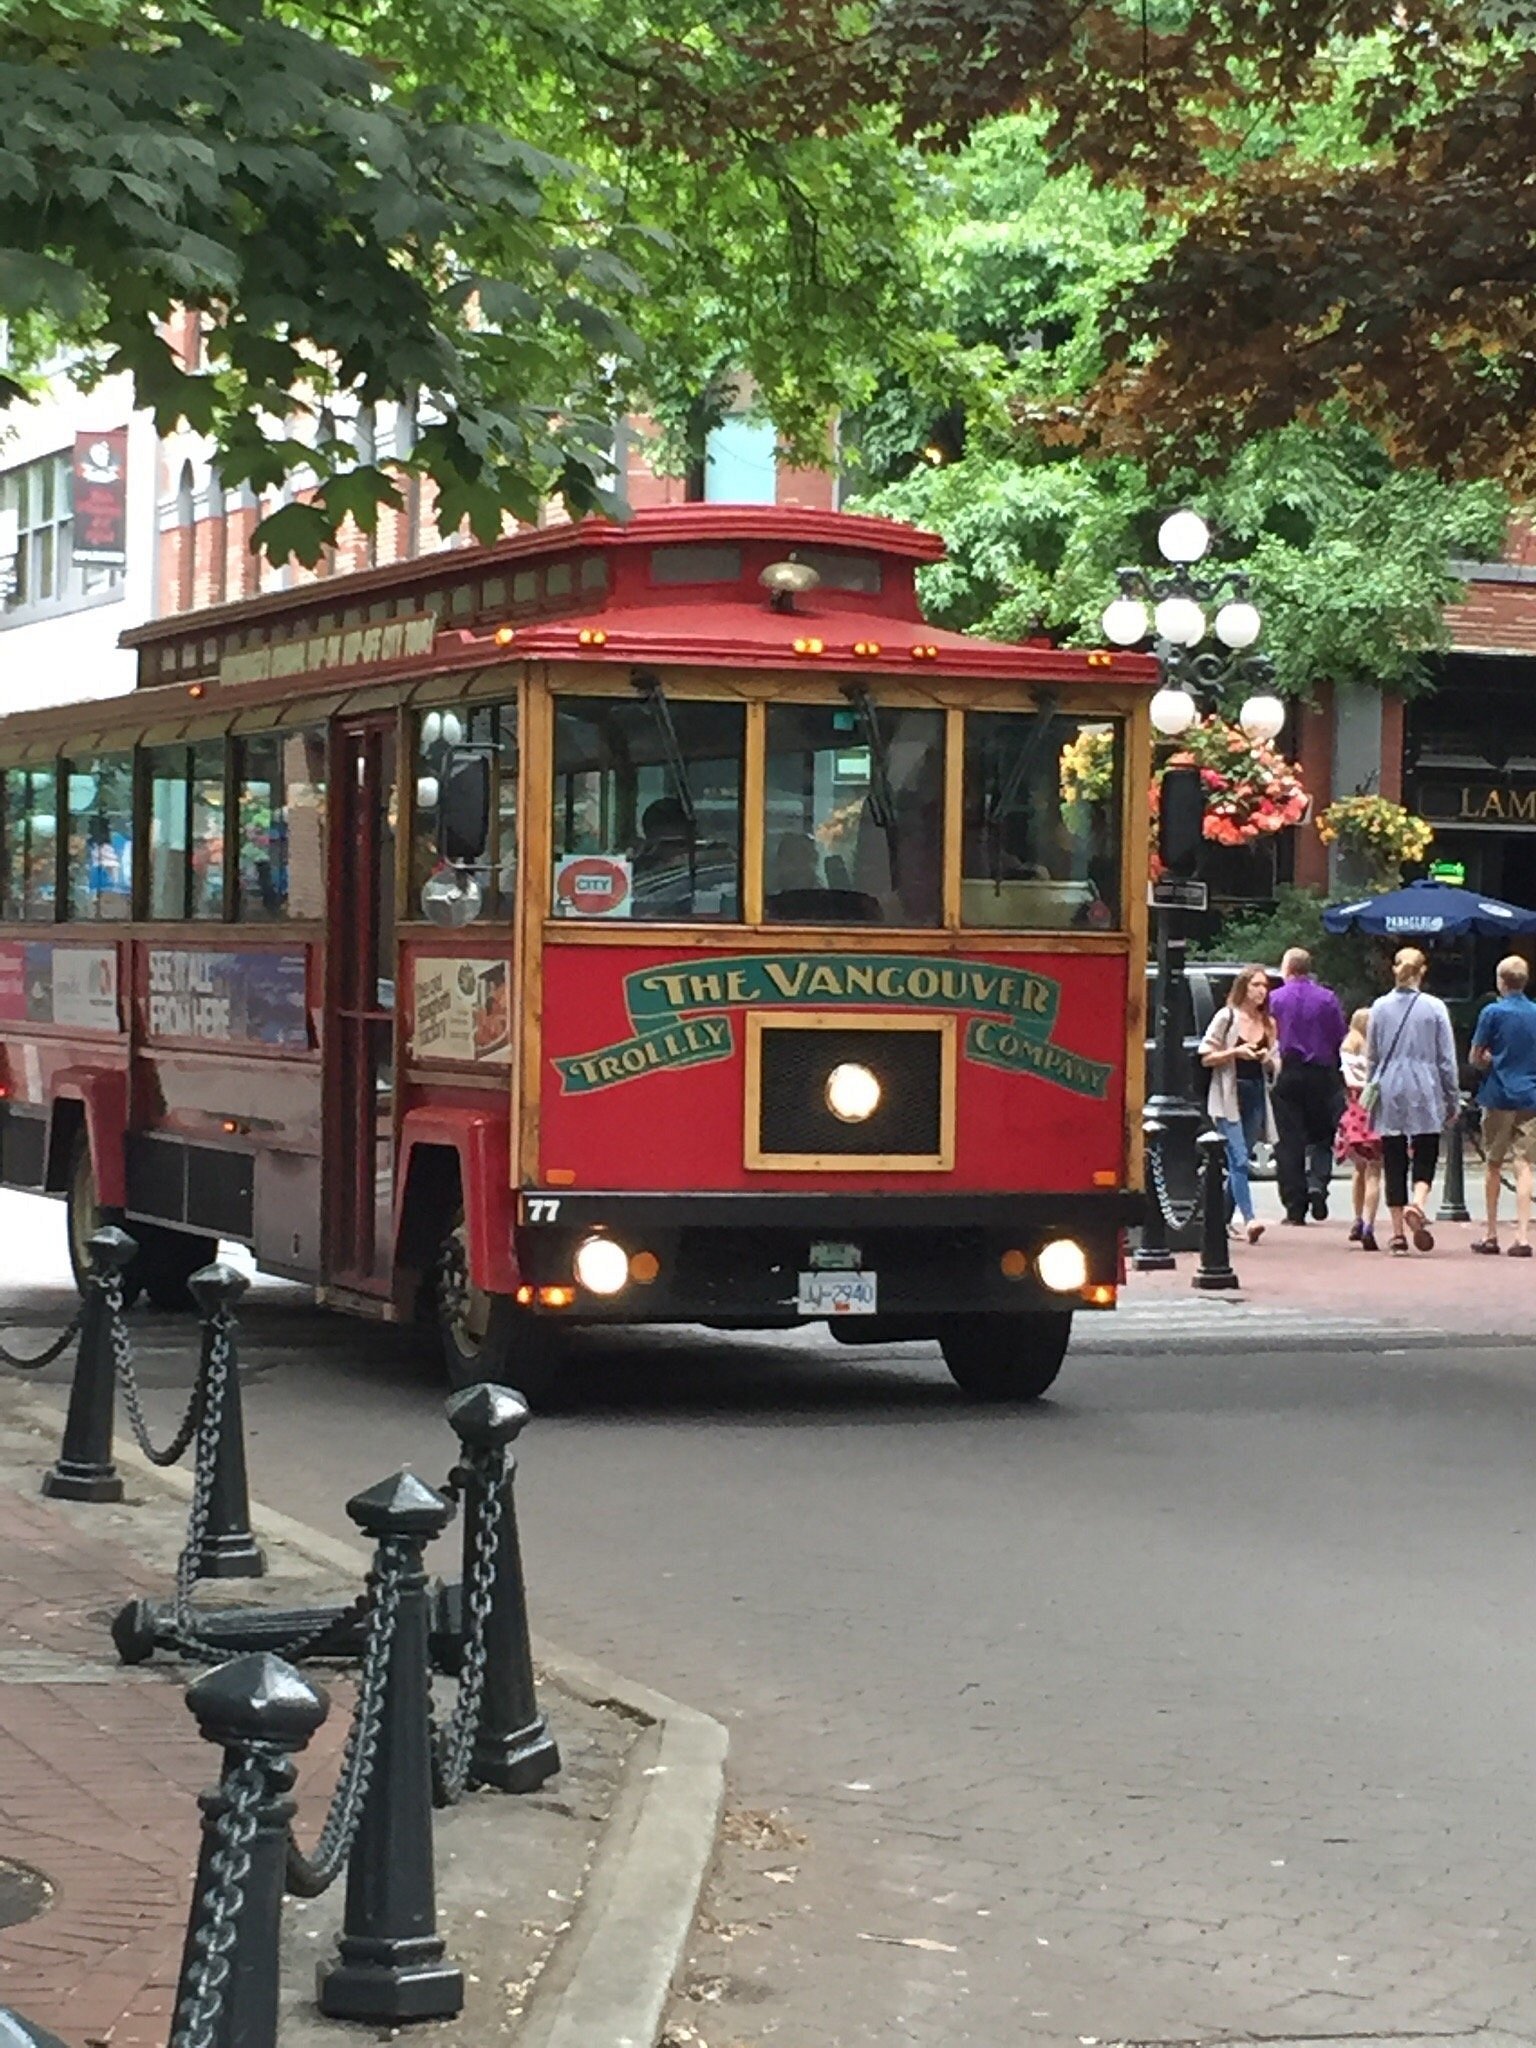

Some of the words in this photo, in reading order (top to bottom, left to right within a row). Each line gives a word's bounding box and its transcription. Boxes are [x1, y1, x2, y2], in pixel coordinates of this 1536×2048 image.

[577, 878, 610, 891] CITY
[642, 969, 761, 1006] THE
[764, 961, 1050, 1014] VANCOUVER
[975, 1023, 1102, 1089] COMPANY
[528, 1199, 560, 1221] 77
